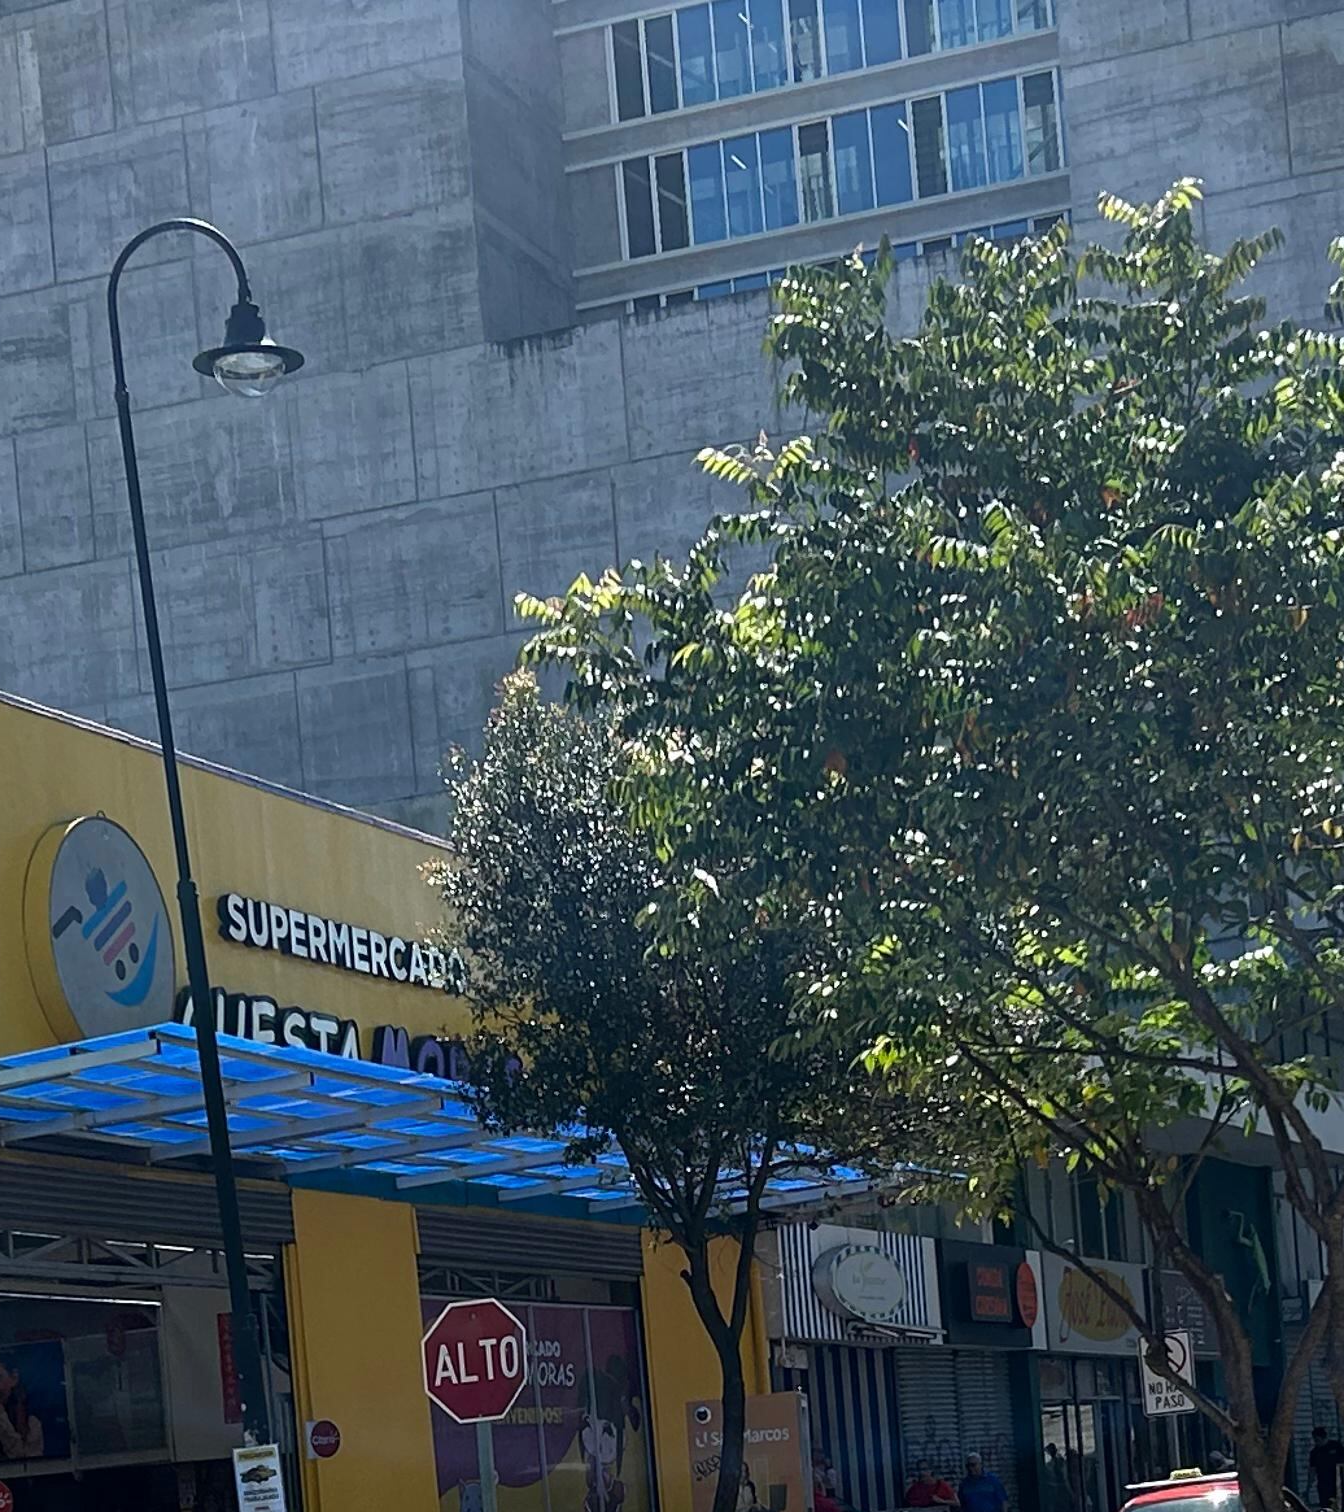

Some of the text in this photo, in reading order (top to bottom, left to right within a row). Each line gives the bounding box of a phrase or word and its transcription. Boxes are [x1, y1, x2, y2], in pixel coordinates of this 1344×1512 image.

[227, 893, 467, 993] SUPERMERCADO
[434, 1335, 519, 1388] ALTO
[1148, 1381, 1181, 1395] NO HA
[1155, 1394, 1185, 1410] PASO
[311, 1434, 337, 1446] Claro
